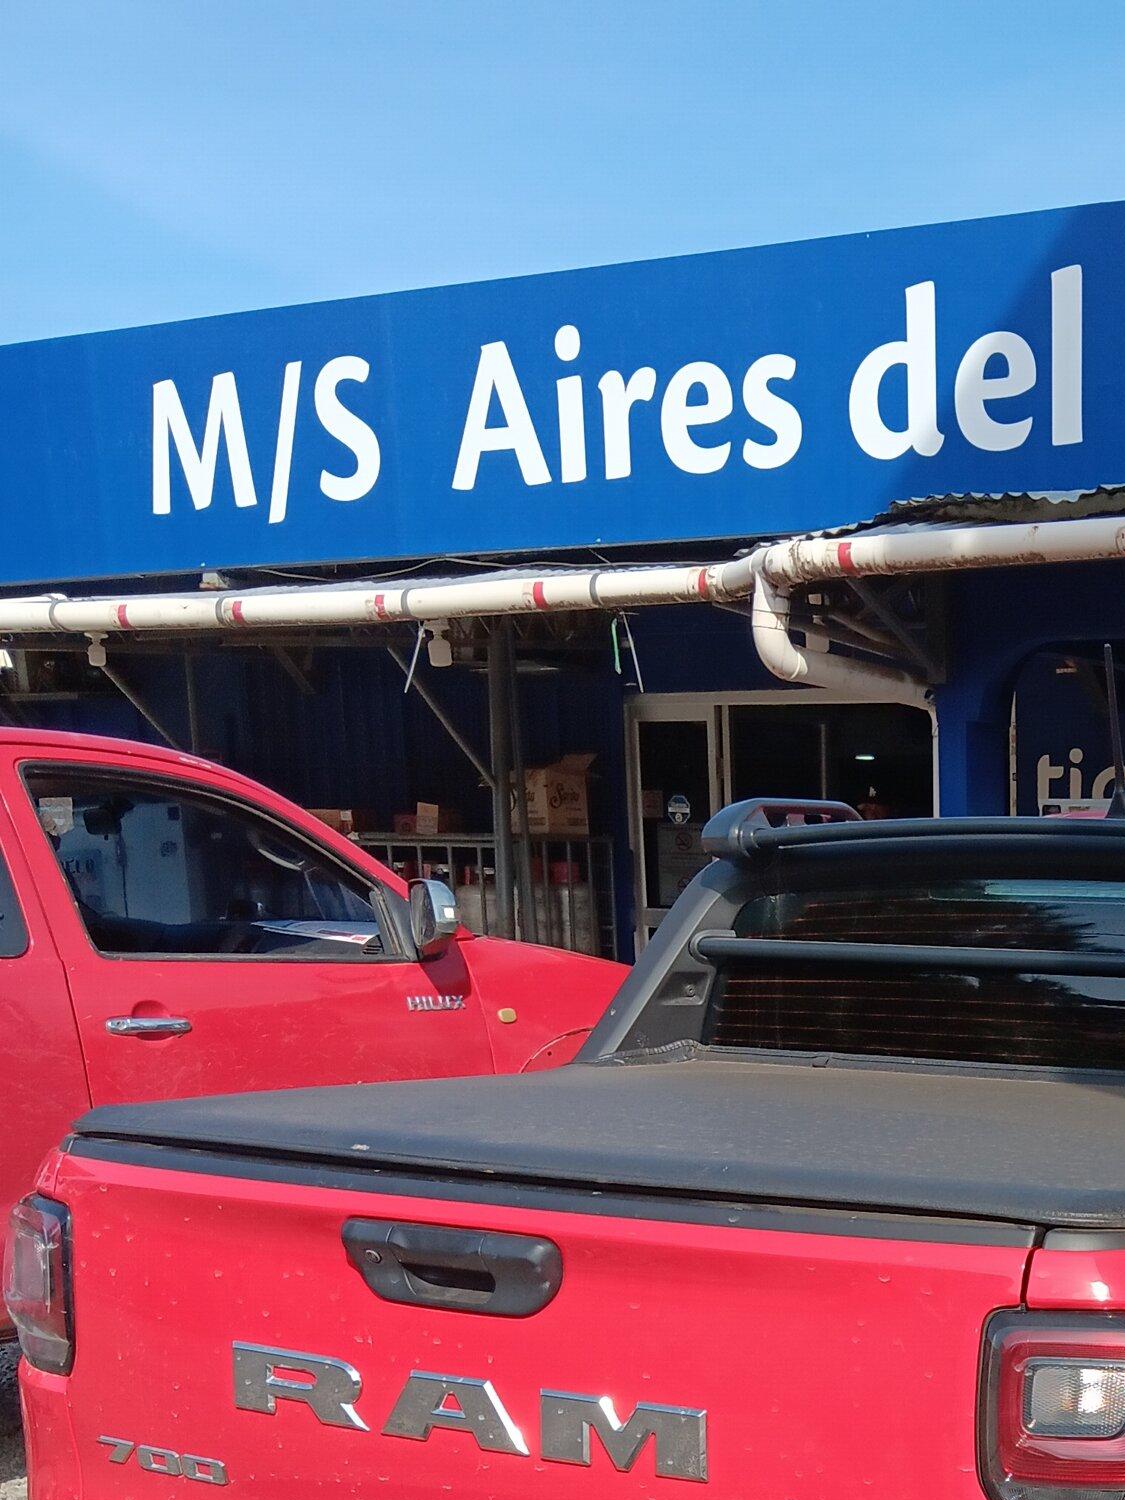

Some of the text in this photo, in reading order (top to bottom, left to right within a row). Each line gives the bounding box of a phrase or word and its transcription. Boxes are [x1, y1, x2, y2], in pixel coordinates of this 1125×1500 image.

[153, 356, 380, 523] M/S
[452, 325, 802, 490] Aires
[849, 265, 1082, 459] del
[406, 995, 466, 1012] HILUX
[98, 1435, 229, 1486] 700
[232, 1340, 709, 1484] RAM
